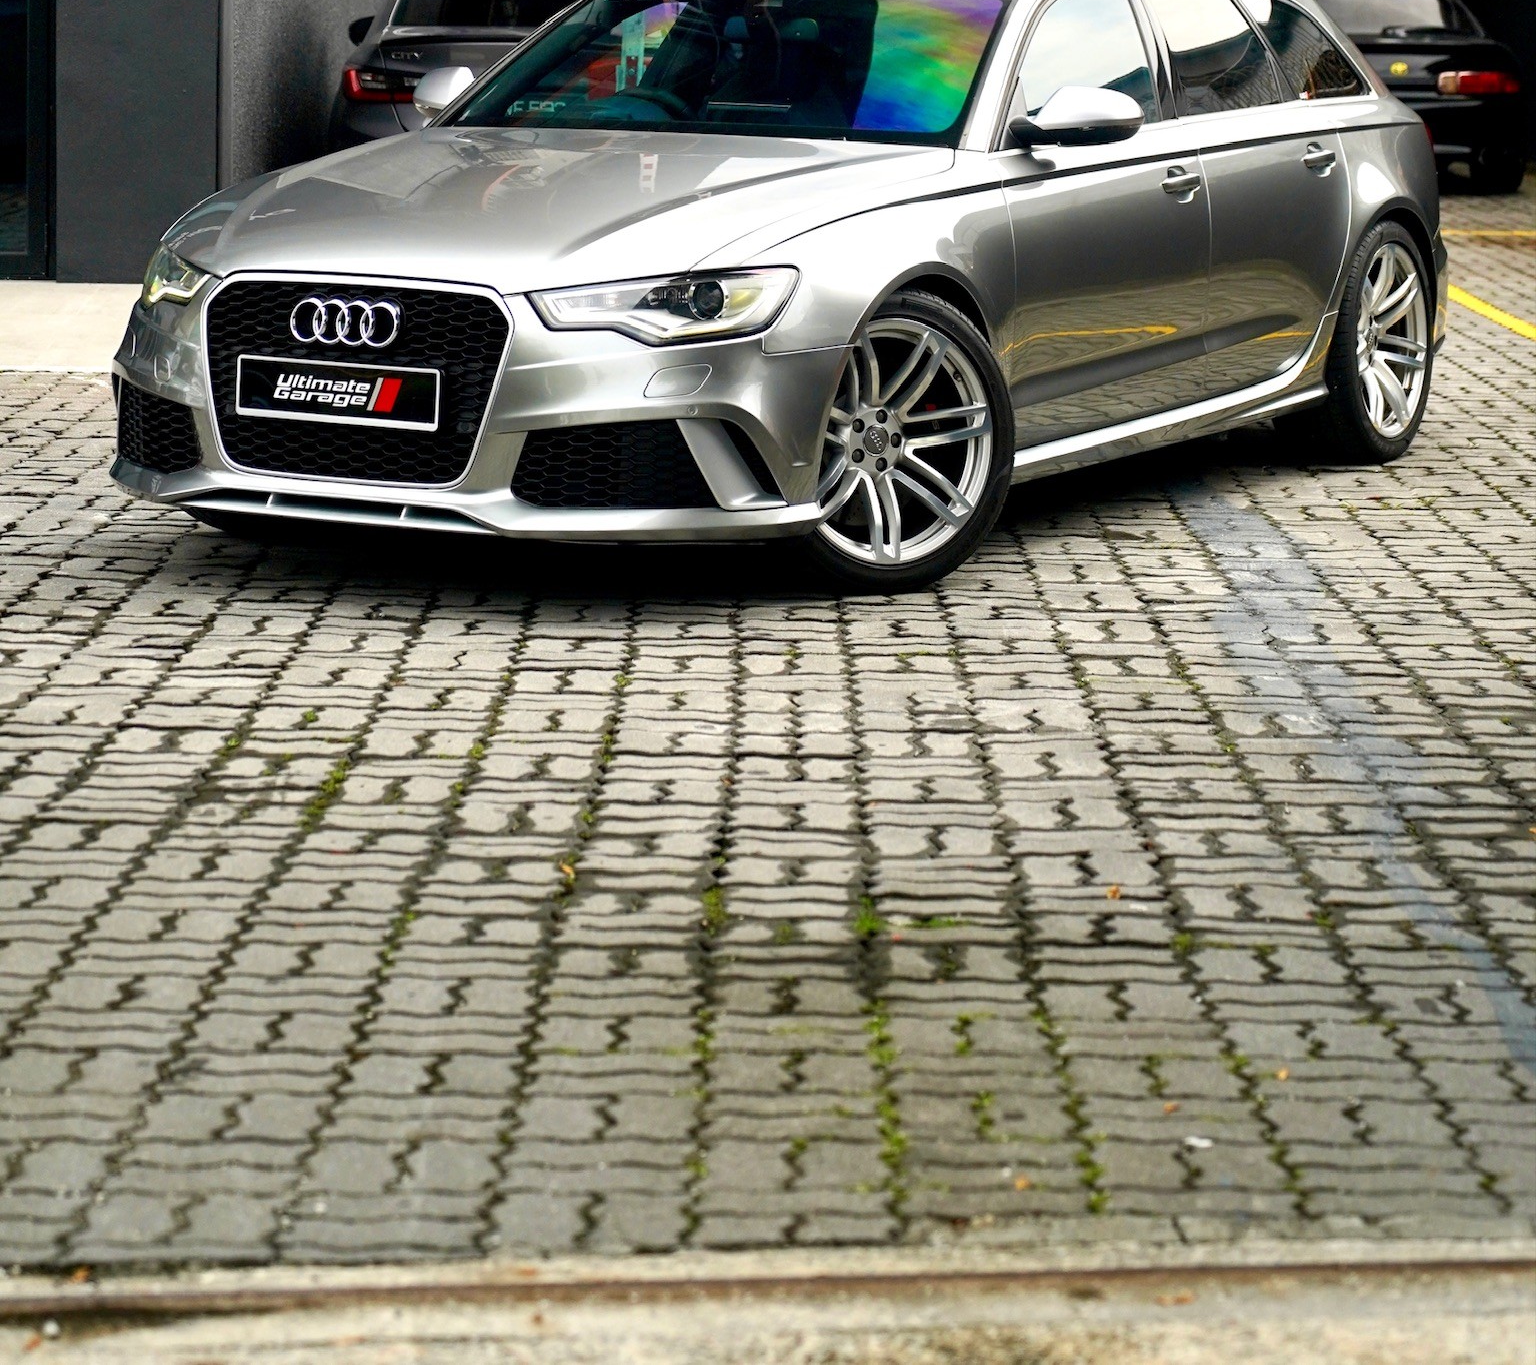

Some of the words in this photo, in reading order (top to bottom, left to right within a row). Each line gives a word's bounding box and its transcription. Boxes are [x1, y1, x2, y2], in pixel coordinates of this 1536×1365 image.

[391, 51, 423, 60] CITY
[276, 373, 371, 394] Ultimate
[273, 387, 368, 408] Garage
